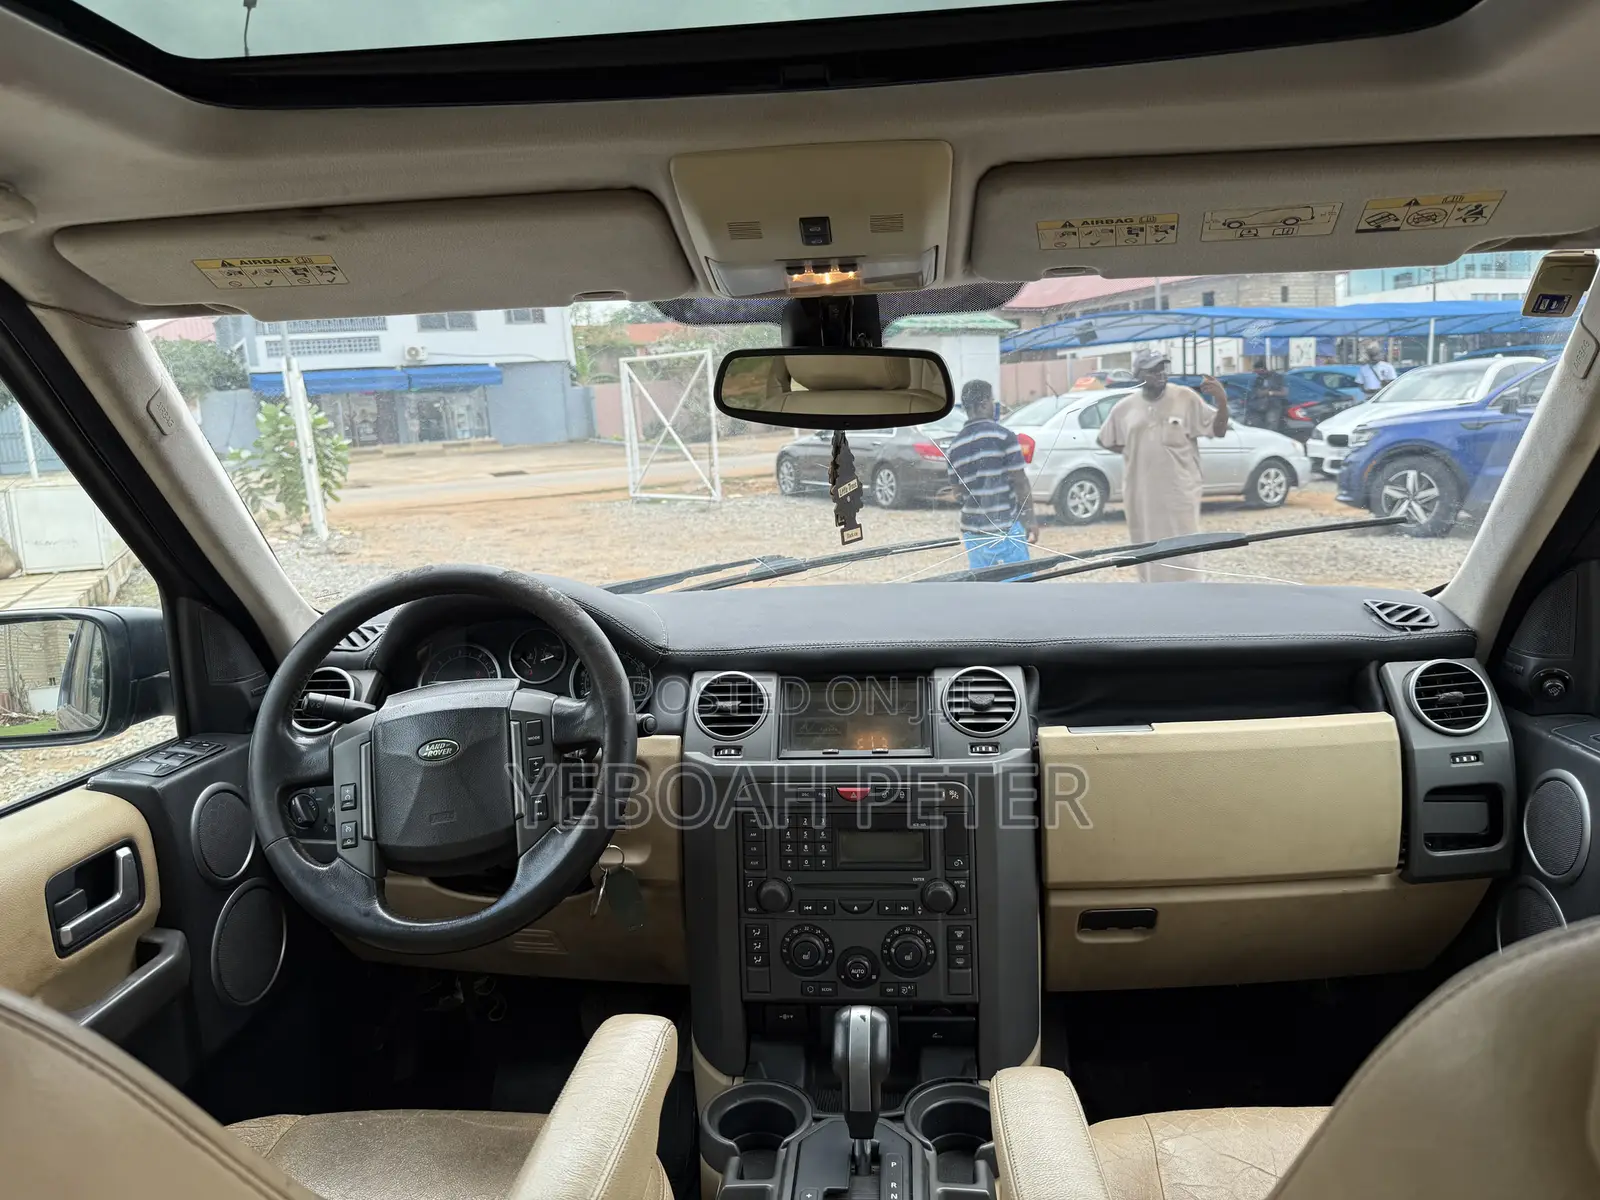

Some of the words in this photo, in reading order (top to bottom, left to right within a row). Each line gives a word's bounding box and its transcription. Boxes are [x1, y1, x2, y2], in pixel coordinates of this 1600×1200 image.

[1081, 217, 1134, 226] AIRBAG
[1573, 339, 1590, 370] AIRBAG
[156, 401, 175, 428] AIRBAG
[426, 743, 446, 751] LAND
[427, 747, 452, 757] ROVER
